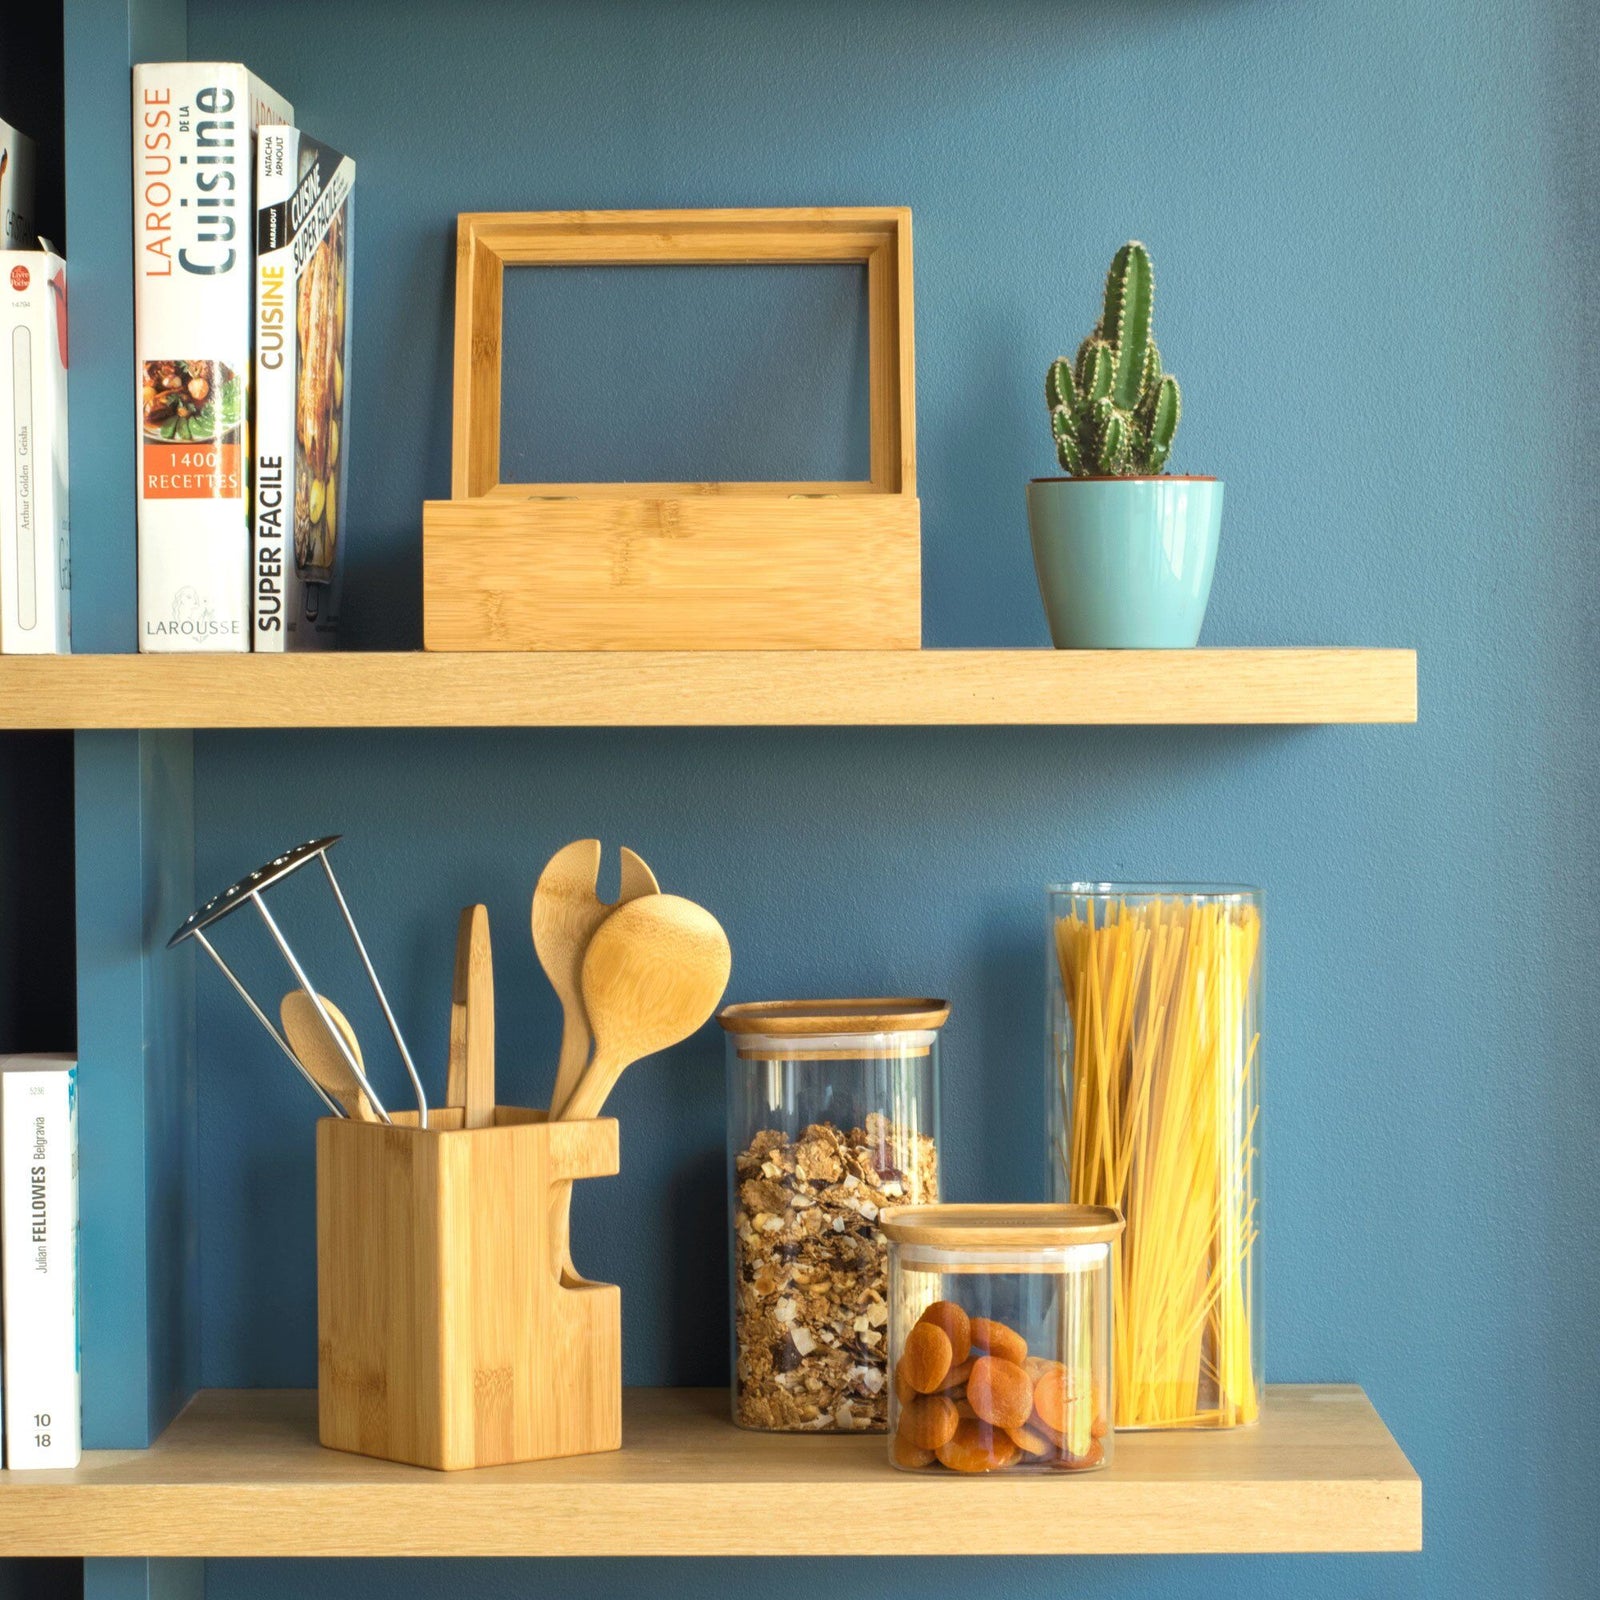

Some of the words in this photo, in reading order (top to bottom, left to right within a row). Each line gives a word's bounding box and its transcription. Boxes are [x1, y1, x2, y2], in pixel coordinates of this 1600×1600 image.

[179, 105, 190, 117] LA
[179, 118, 190, 132] DE
[265, 136, 273, 177] NATACHA
[275, 136, 284, 176] ARNOULT
[145, 88, 171, 277] LAROUSSE
[178, 86, 236, 276] Cuisine
[291, 163, 320, 232] CUISINE
[294, 214, 317, 274] SUPER
[261, 266, 284, 370] CUISINE
[18, 426, 28, 456] Geisha
[171, 452, 217, 467] 1400
[19, 464, 29, 497] Golden
[148, 474, 238, 489] RECETTES
[259, 455, 282, 537] FACILE
[20, 500, 30, 530] Arthur
[259, 547, 281, 632] SUPER
[147, 621, 240, 635] LAROUSSE
[33, 1116, 48, 1160] Belgravia
[31, 1166, 47, 1242] FELLOWES
[35, 1245, 48, 1274] Julian
[34, 1413, 51, 1427] 10
[34, 1434, 51, 1447] 18
